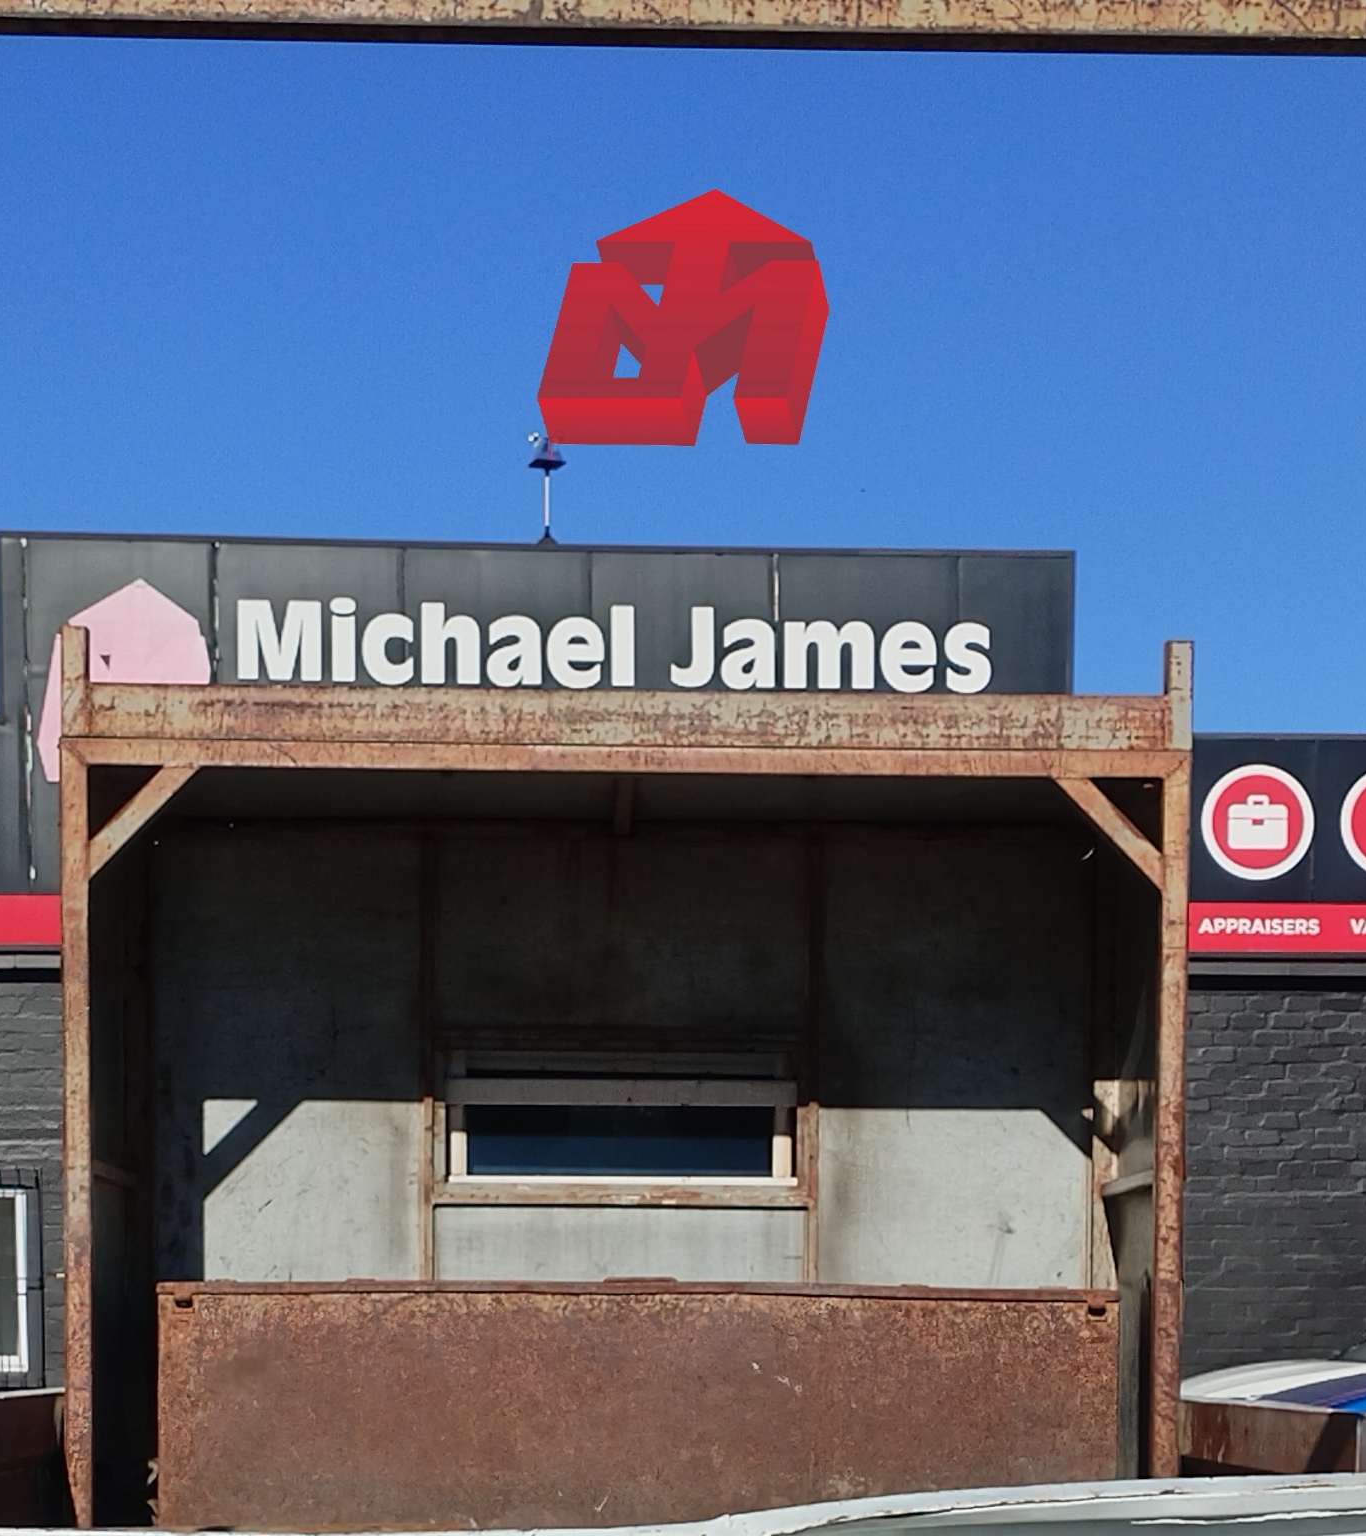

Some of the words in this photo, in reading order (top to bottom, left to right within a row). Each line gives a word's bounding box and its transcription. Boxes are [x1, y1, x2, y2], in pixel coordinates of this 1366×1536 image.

[237, 598, 635, 688] Michael
[670, 606, 992, 694] James
[1197, 917, 1321, 936] APPRAISERS
